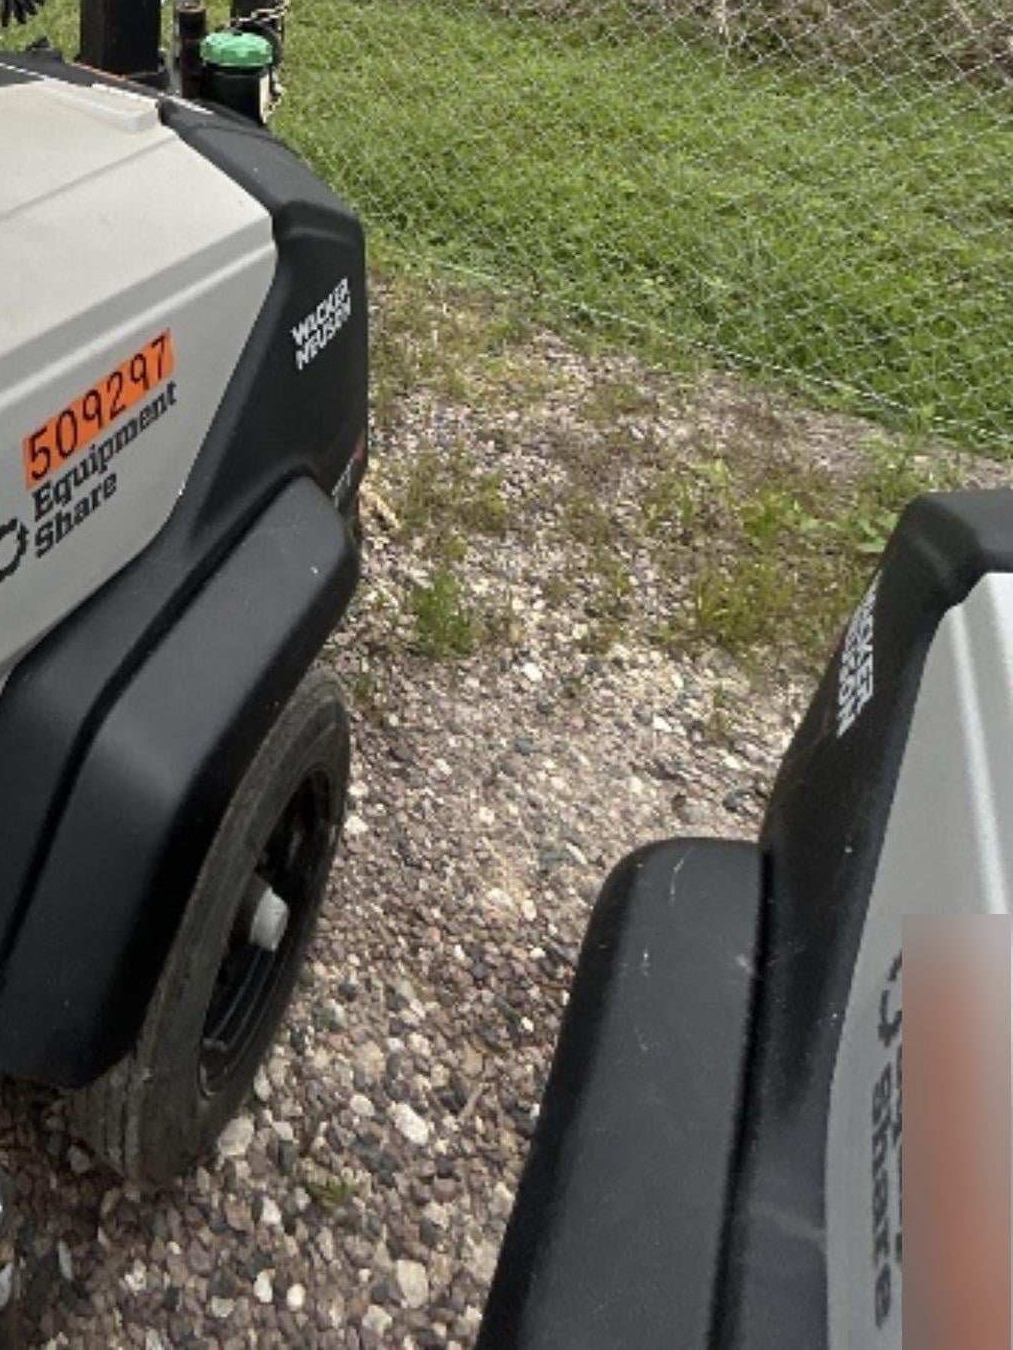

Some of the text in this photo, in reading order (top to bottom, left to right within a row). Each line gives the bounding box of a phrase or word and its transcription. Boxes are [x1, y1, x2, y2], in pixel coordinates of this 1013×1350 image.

[28, 334, 167, 482] 509297
[32, 380, 178, 523] Equipment
[35, 471, 118, 559] Share
